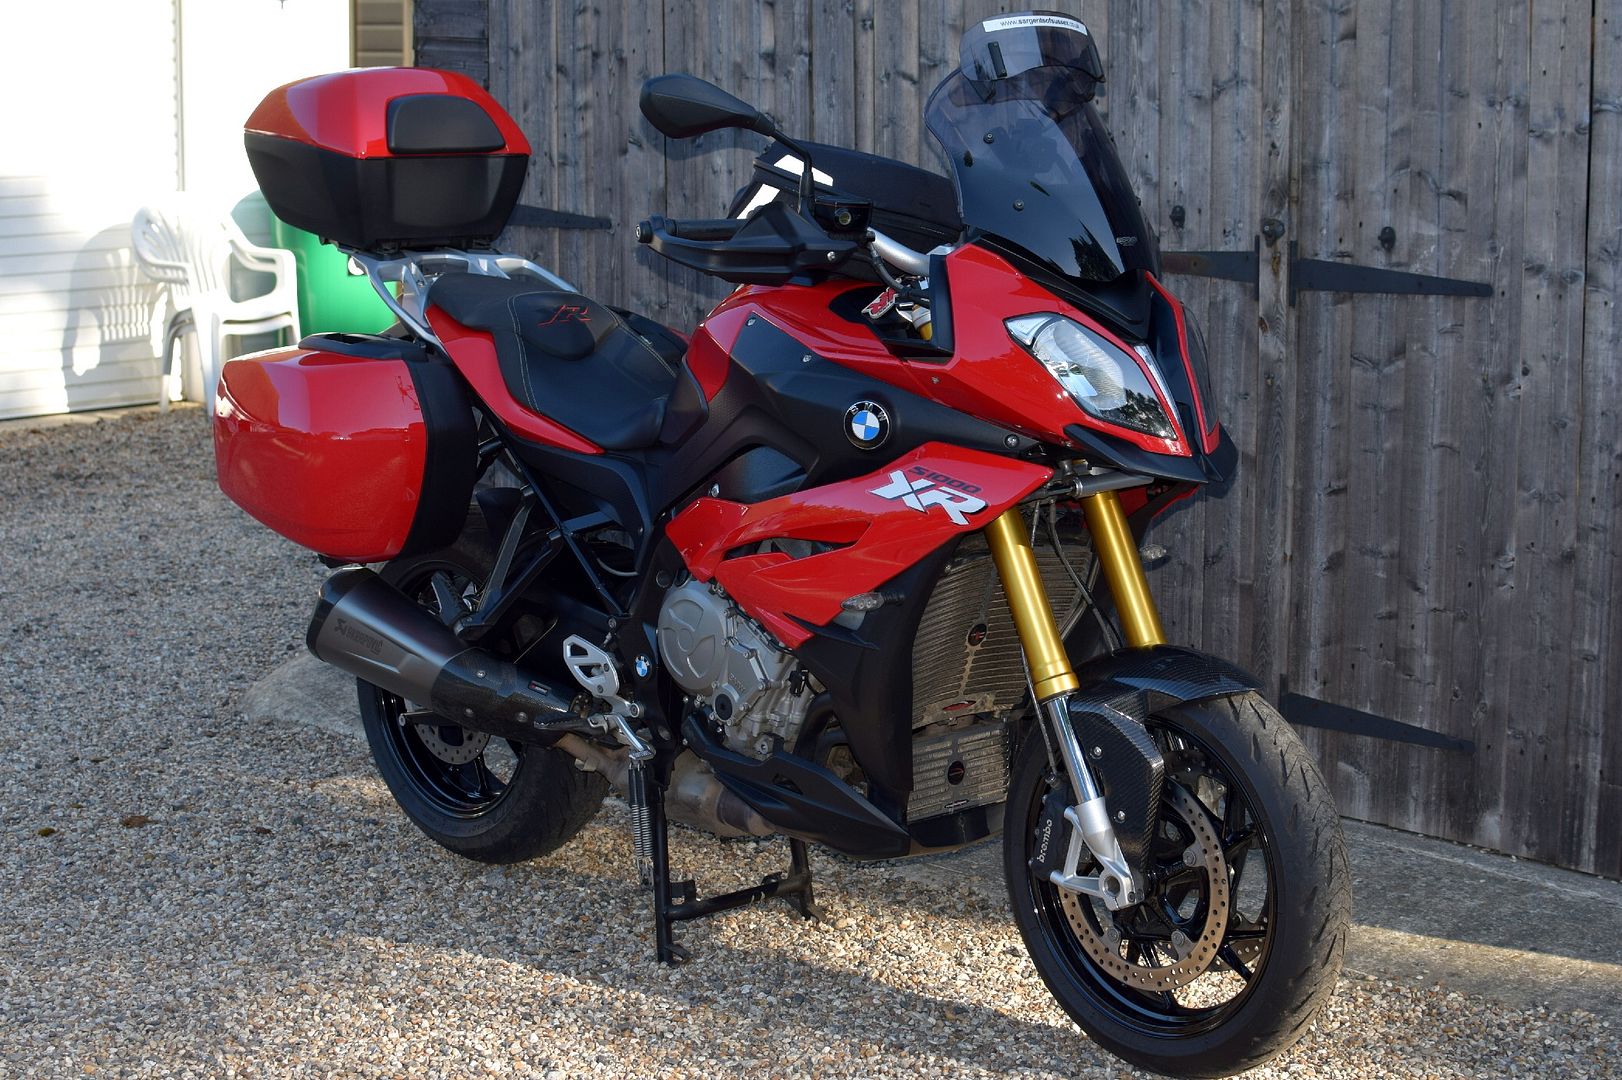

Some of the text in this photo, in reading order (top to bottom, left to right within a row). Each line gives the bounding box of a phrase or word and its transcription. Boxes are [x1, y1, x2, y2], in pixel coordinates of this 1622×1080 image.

[868, 470, 989, 525] XR
[908, 466, 982, 494] S1000
[1037, 819, 1053, 863] brembo
